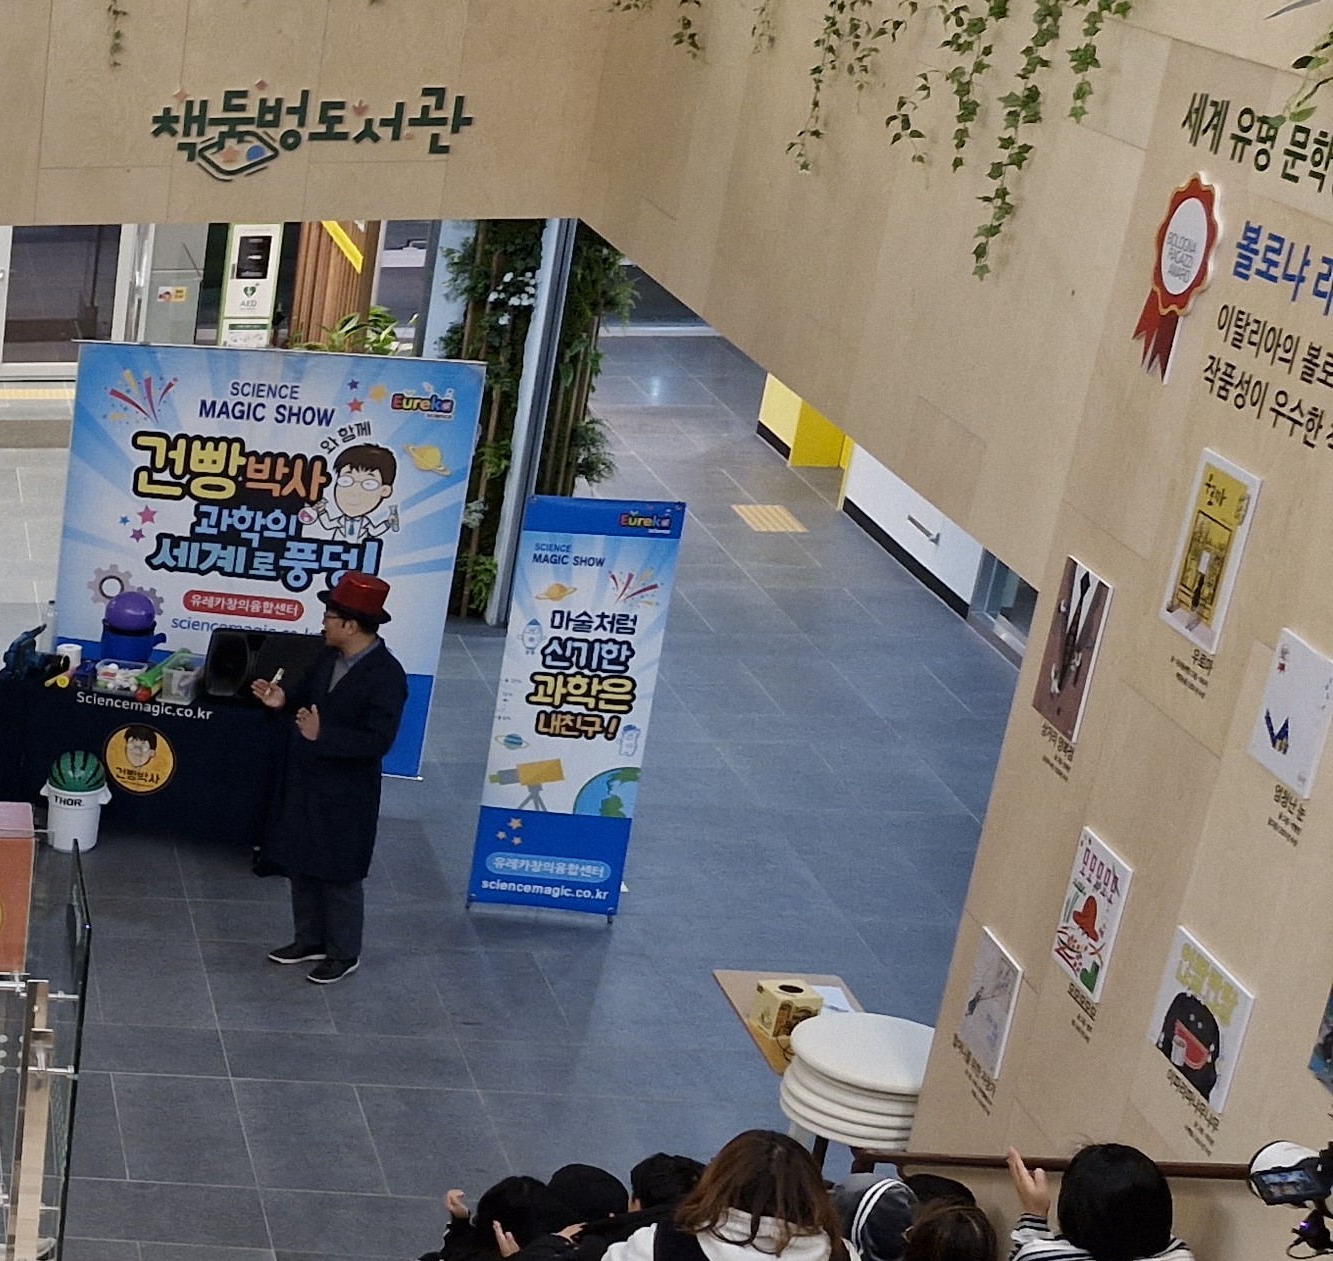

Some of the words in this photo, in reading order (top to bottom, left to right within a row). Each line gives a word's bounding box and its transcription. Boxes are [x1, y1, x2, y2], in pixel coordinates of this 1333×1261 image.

[1181, 92, 1231, 155] 세계
[1230, 107, 1279, 172] 유명
[1233, 221, 1311, 302] 볼로냐
[1217, 304, 1301, 375] 이탈리아의
[229, 381, 300, 400] SCIENCE
[1203, 354, 1269, 419] 작품성이
[1270, 390, 1324, 449] 우수한
[199, 400, 266, 423] MAGIC
[274, 404, 335, 427] SHOW
[337, 421, 372, 443] 함께
[135, 434, 329, 501] 건빵박사
[194, 504, 298, 547] 과학의
[149, 538, 277, 577] 세계로
[533, 554, 569, 566] MAGIC
[573, 555, 605, 567] SHOW
[534, 542, 572, 553] SCIENCE
[550, 610, 638, 635] 마술처럼
[543, 639, 633, 671] 신기한
[76, 691, 213, 720] Sciencemagic.co.kr
[529, 674, 634, 711] 과학은
[116, 767, 160, 785] 건빵박사
[481, 880, 609, 900] sciencemagic.co.kr
